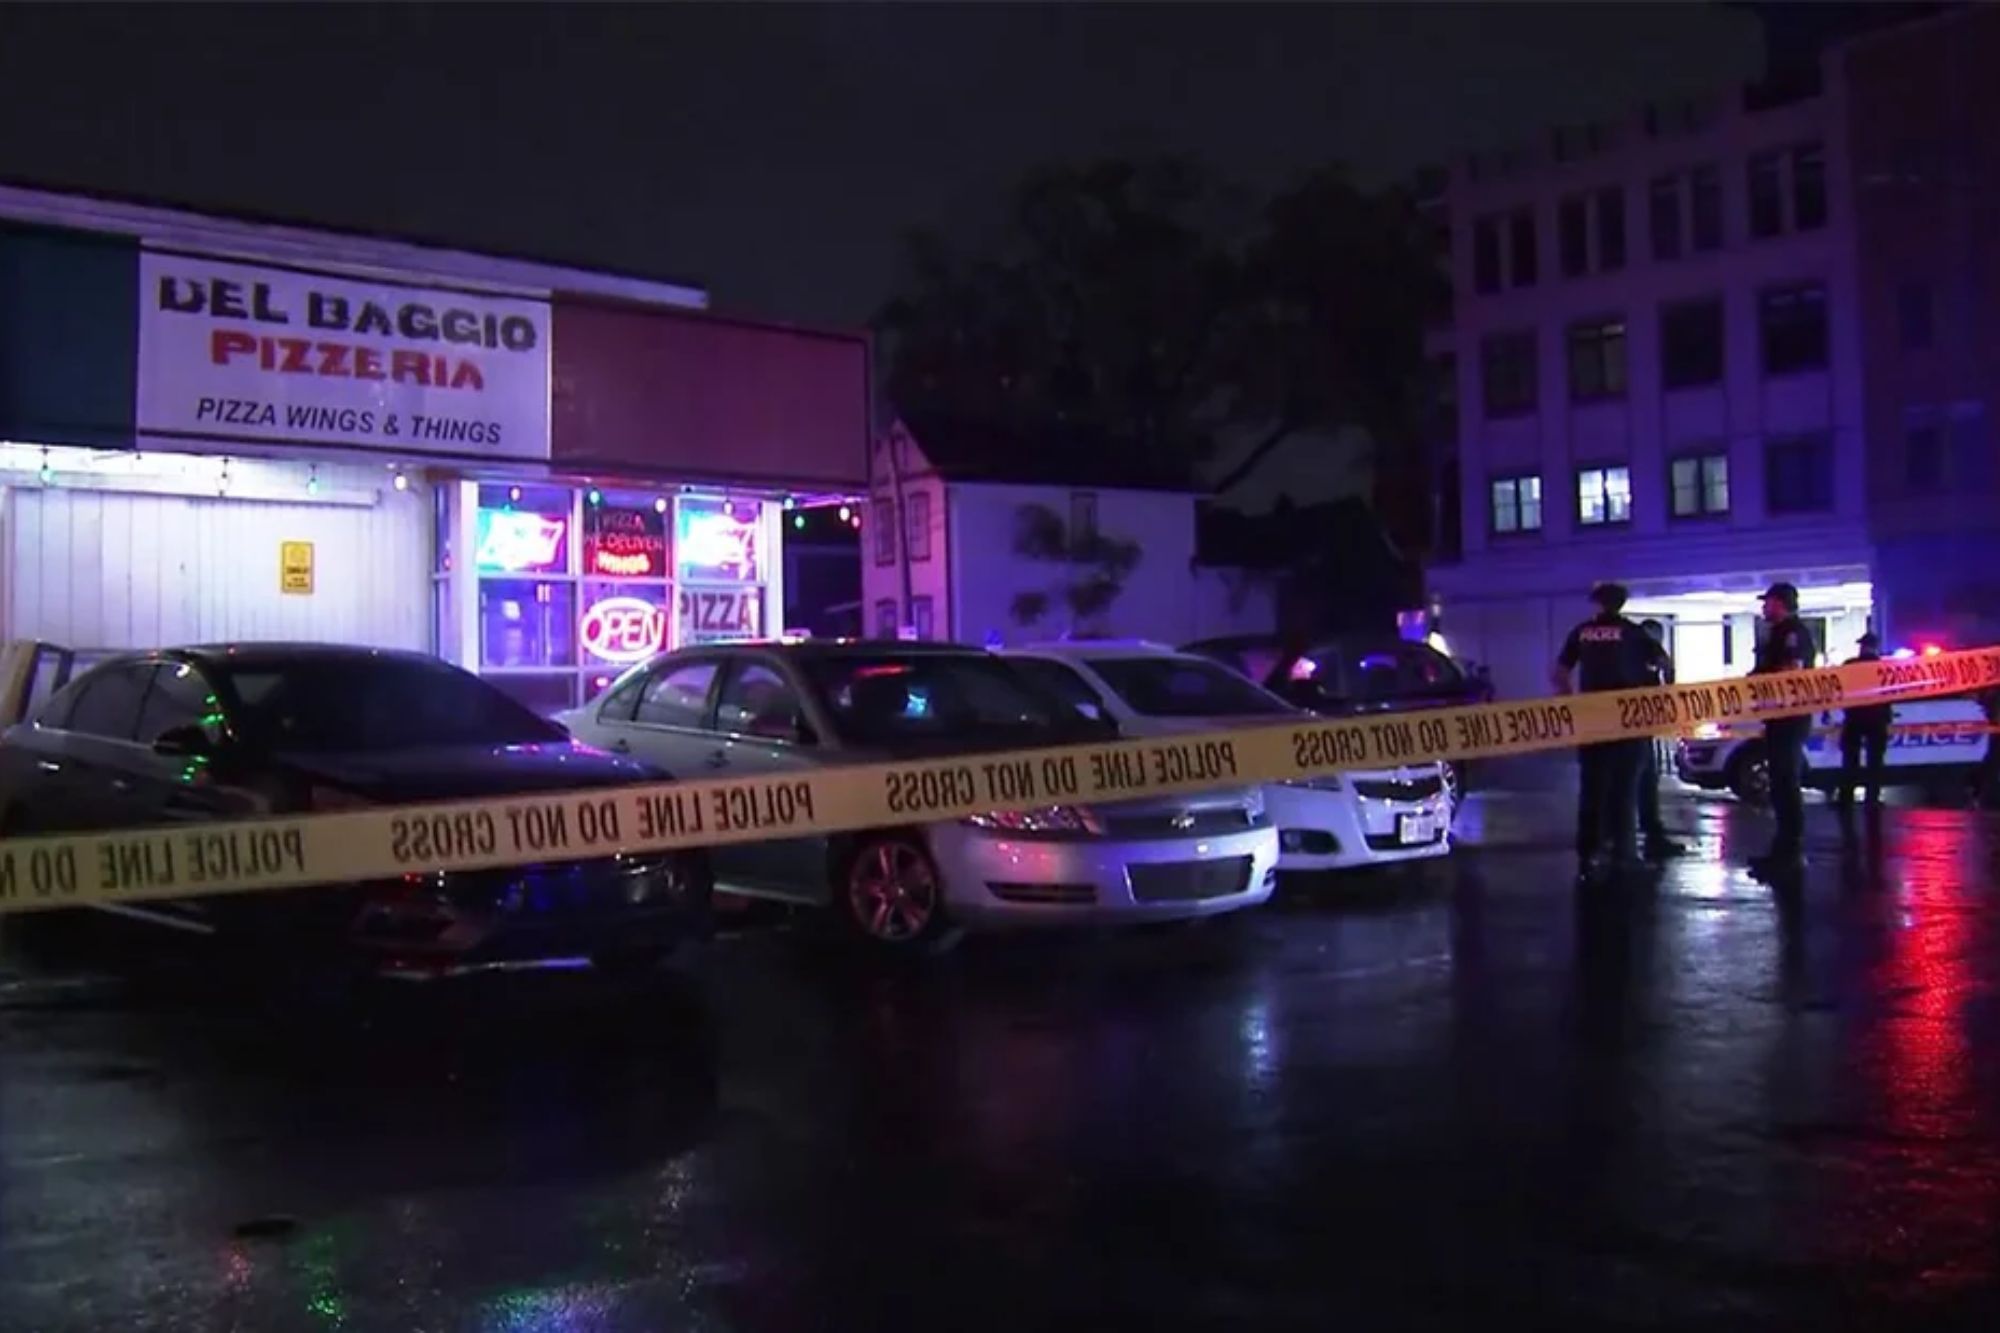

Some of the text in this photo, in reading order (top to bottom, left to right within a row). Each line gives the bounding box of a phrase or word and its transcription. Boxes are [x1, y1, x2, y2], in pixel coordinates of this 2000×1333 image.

[159, 276, 537, 352] DEL BAGGIO
[210, 329, 485, 391] PIZZERIA
[196, 397, 502, 444] PIZZA WINGS & THINGS
[582, 608, 664, 651] OPEN
[680, 591, 753, 631] PIZZA
